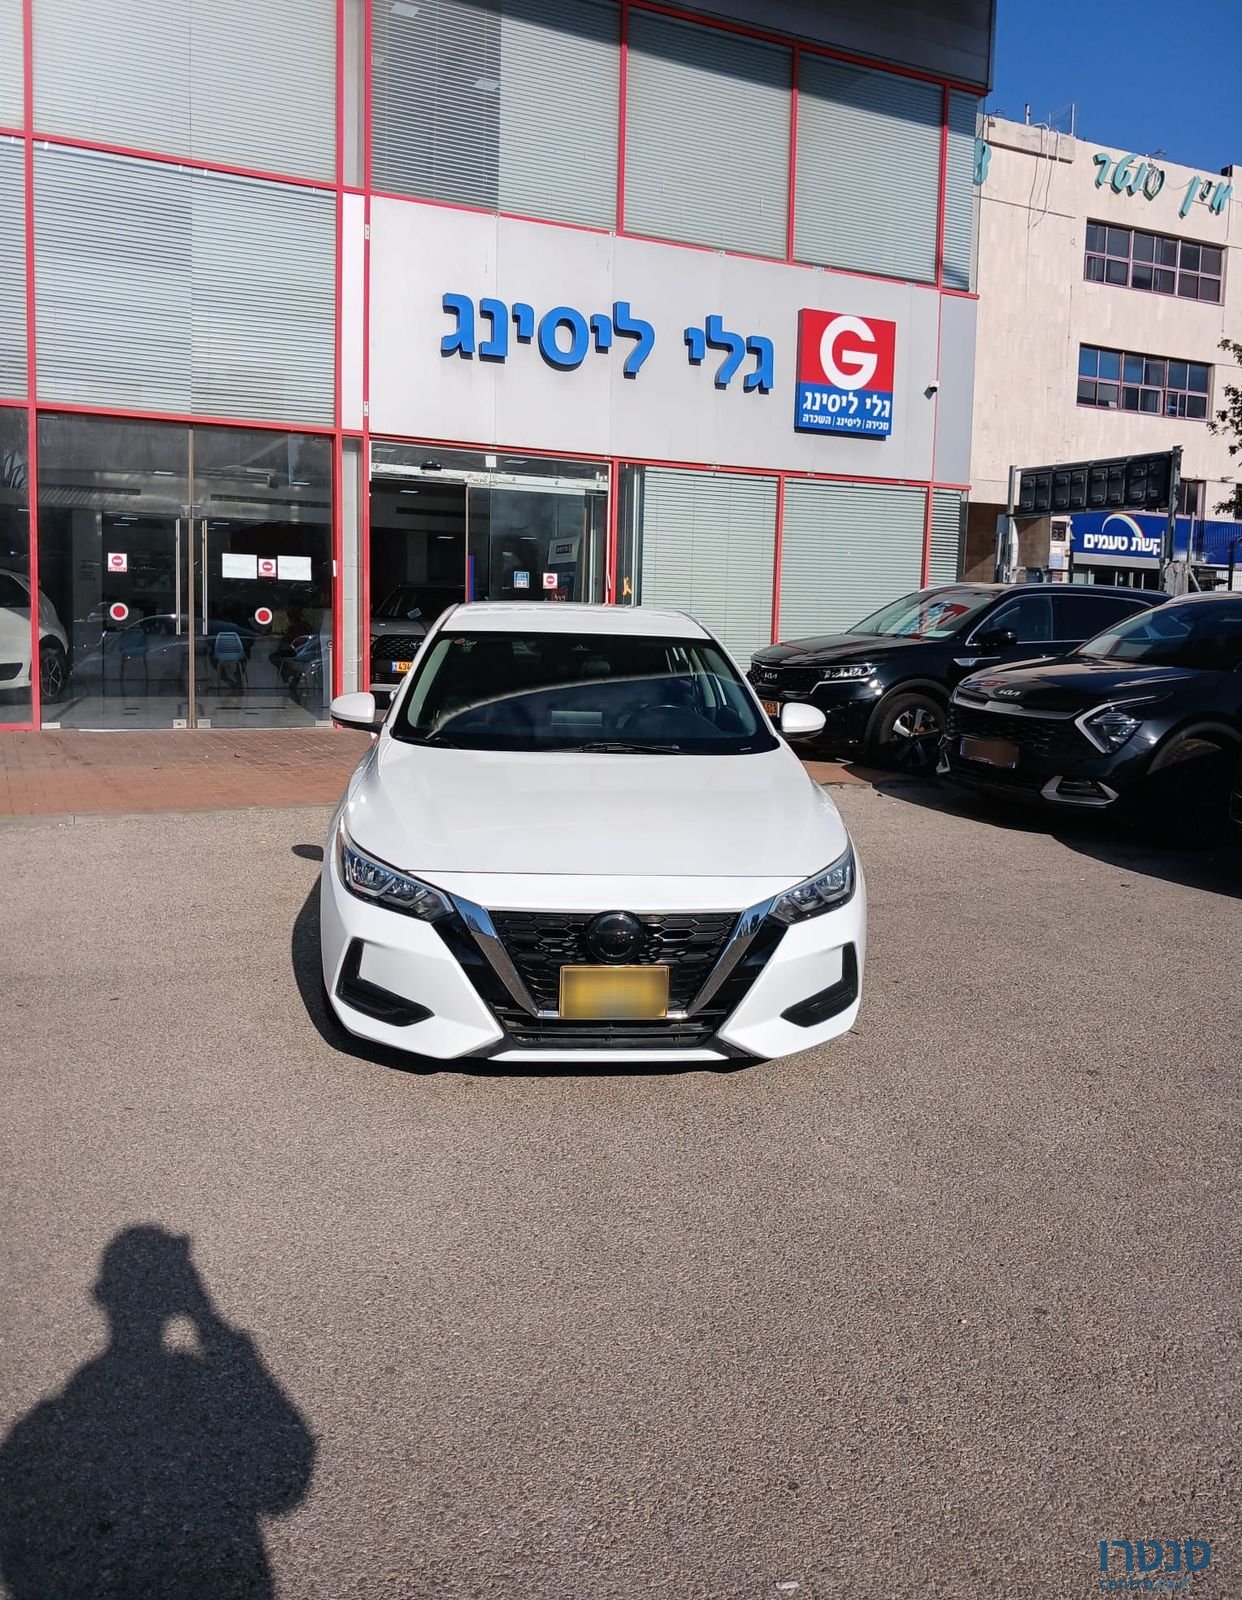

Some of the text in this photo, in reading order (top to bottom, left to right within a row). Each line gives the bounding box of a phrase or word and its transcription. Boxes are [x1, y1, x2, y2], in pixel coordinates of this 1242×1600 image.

[440, 292, 774, 393] גלי ליסינג
[820, 314, 878, 391] G
[802, 391, 891, 418] גלי ליסינג
[802, 413, 889, 431] מכירה ליסינג השכרה
[1083, 533, 1161, 556] קשת טעמים
